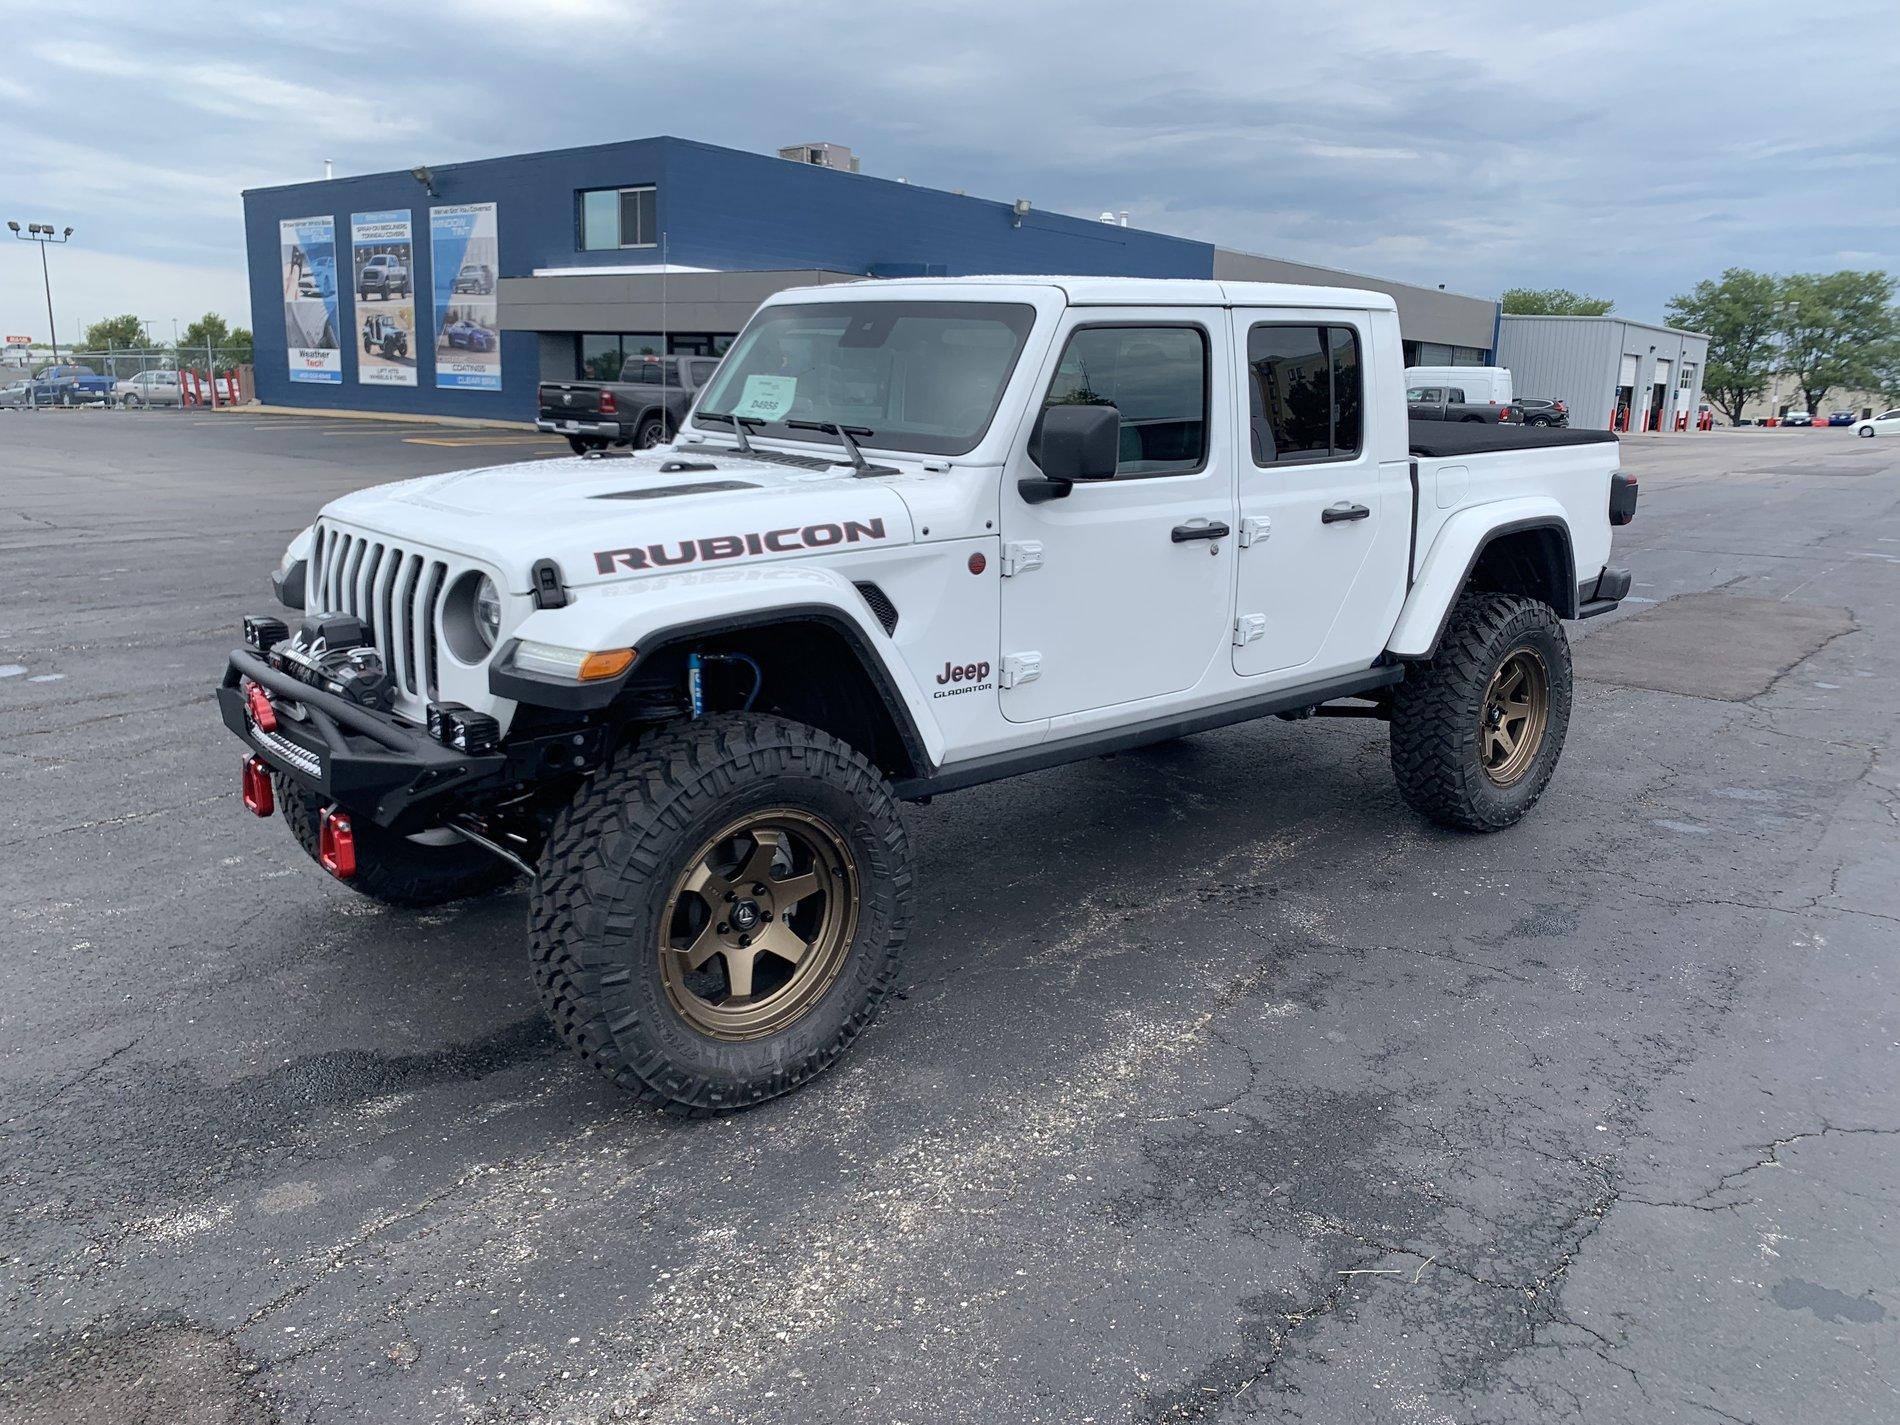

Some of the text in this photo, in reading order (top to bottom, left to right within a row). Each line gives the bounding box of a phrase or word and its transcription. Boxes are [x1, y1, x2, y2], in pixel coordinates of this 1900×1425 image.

[299, 350, 330, 359] Weather
[452, 364, 487, 373] COATINGS
[594, 518, 886, 575] RUBICON
[936, 661, 990, 685] Jeep
[933, 683, 992, 699] GLADIATOR
